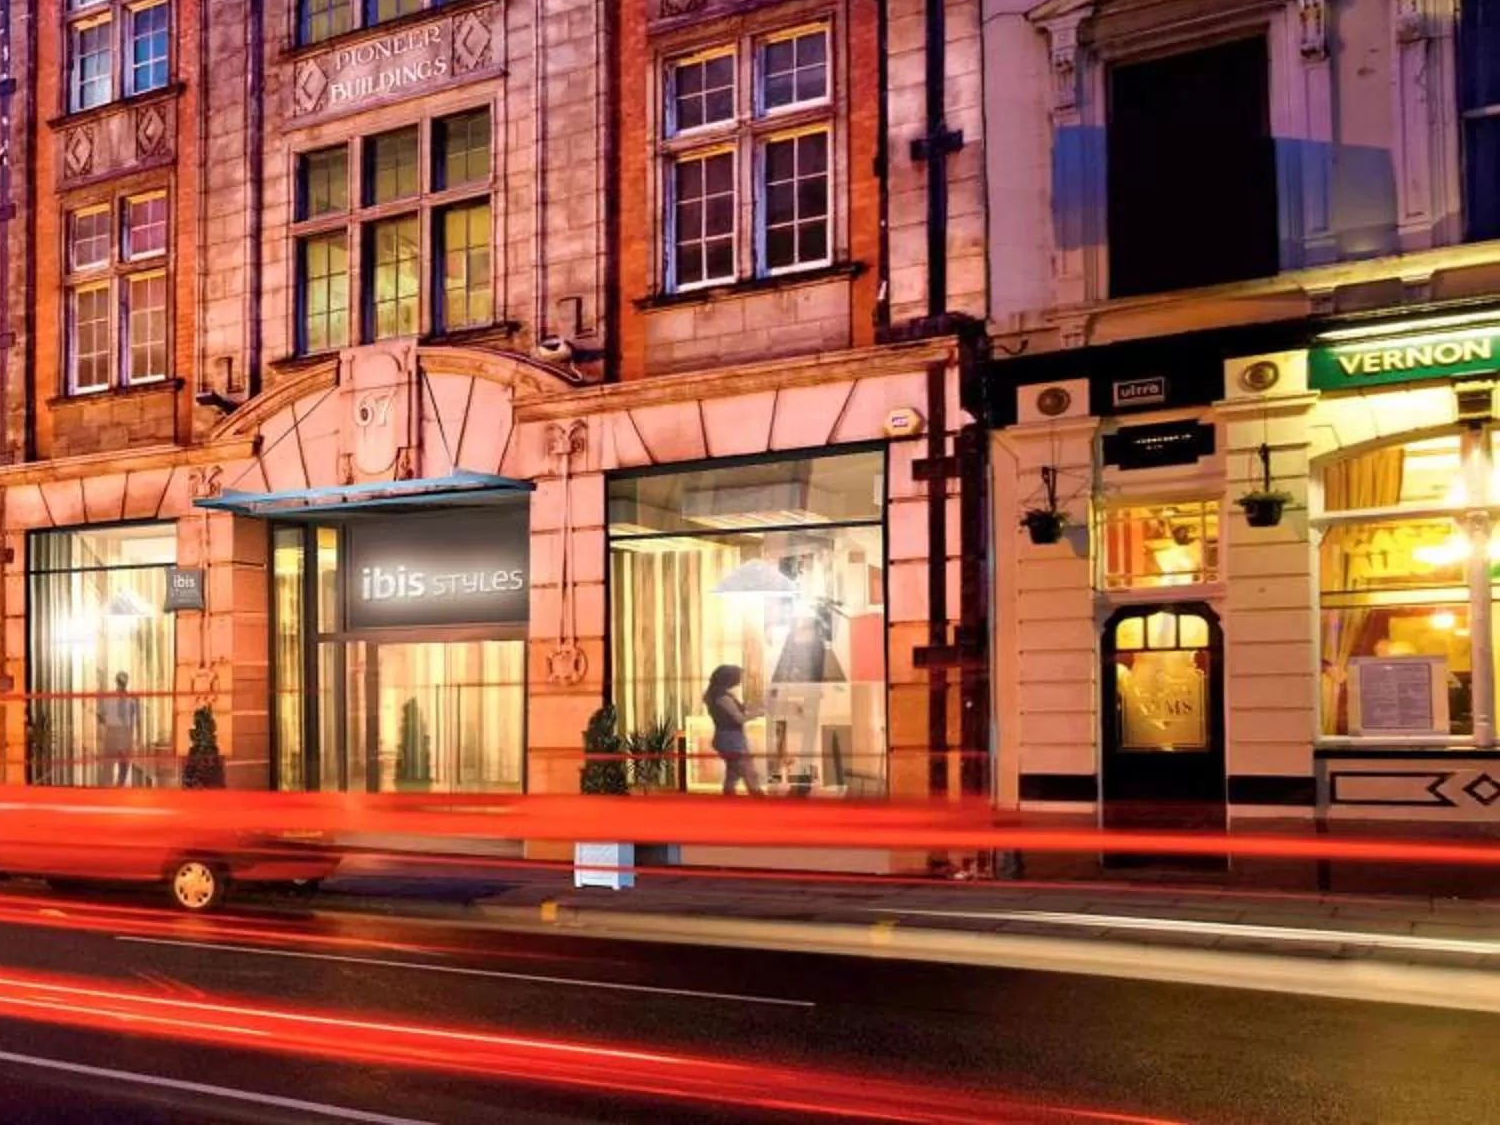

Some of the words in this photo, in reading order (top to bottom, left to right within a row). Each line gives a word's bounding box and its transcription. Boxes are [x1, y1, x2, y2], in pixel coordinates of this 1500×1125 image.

[335, 26, 441, 70] PIONEER
[331, 56, 447, 104] BUILDINGS
[1338, 338, 1492, 375] VERNON
[173, 574, 196, 588] ibis
[362, 565, 426, 601] ibis
